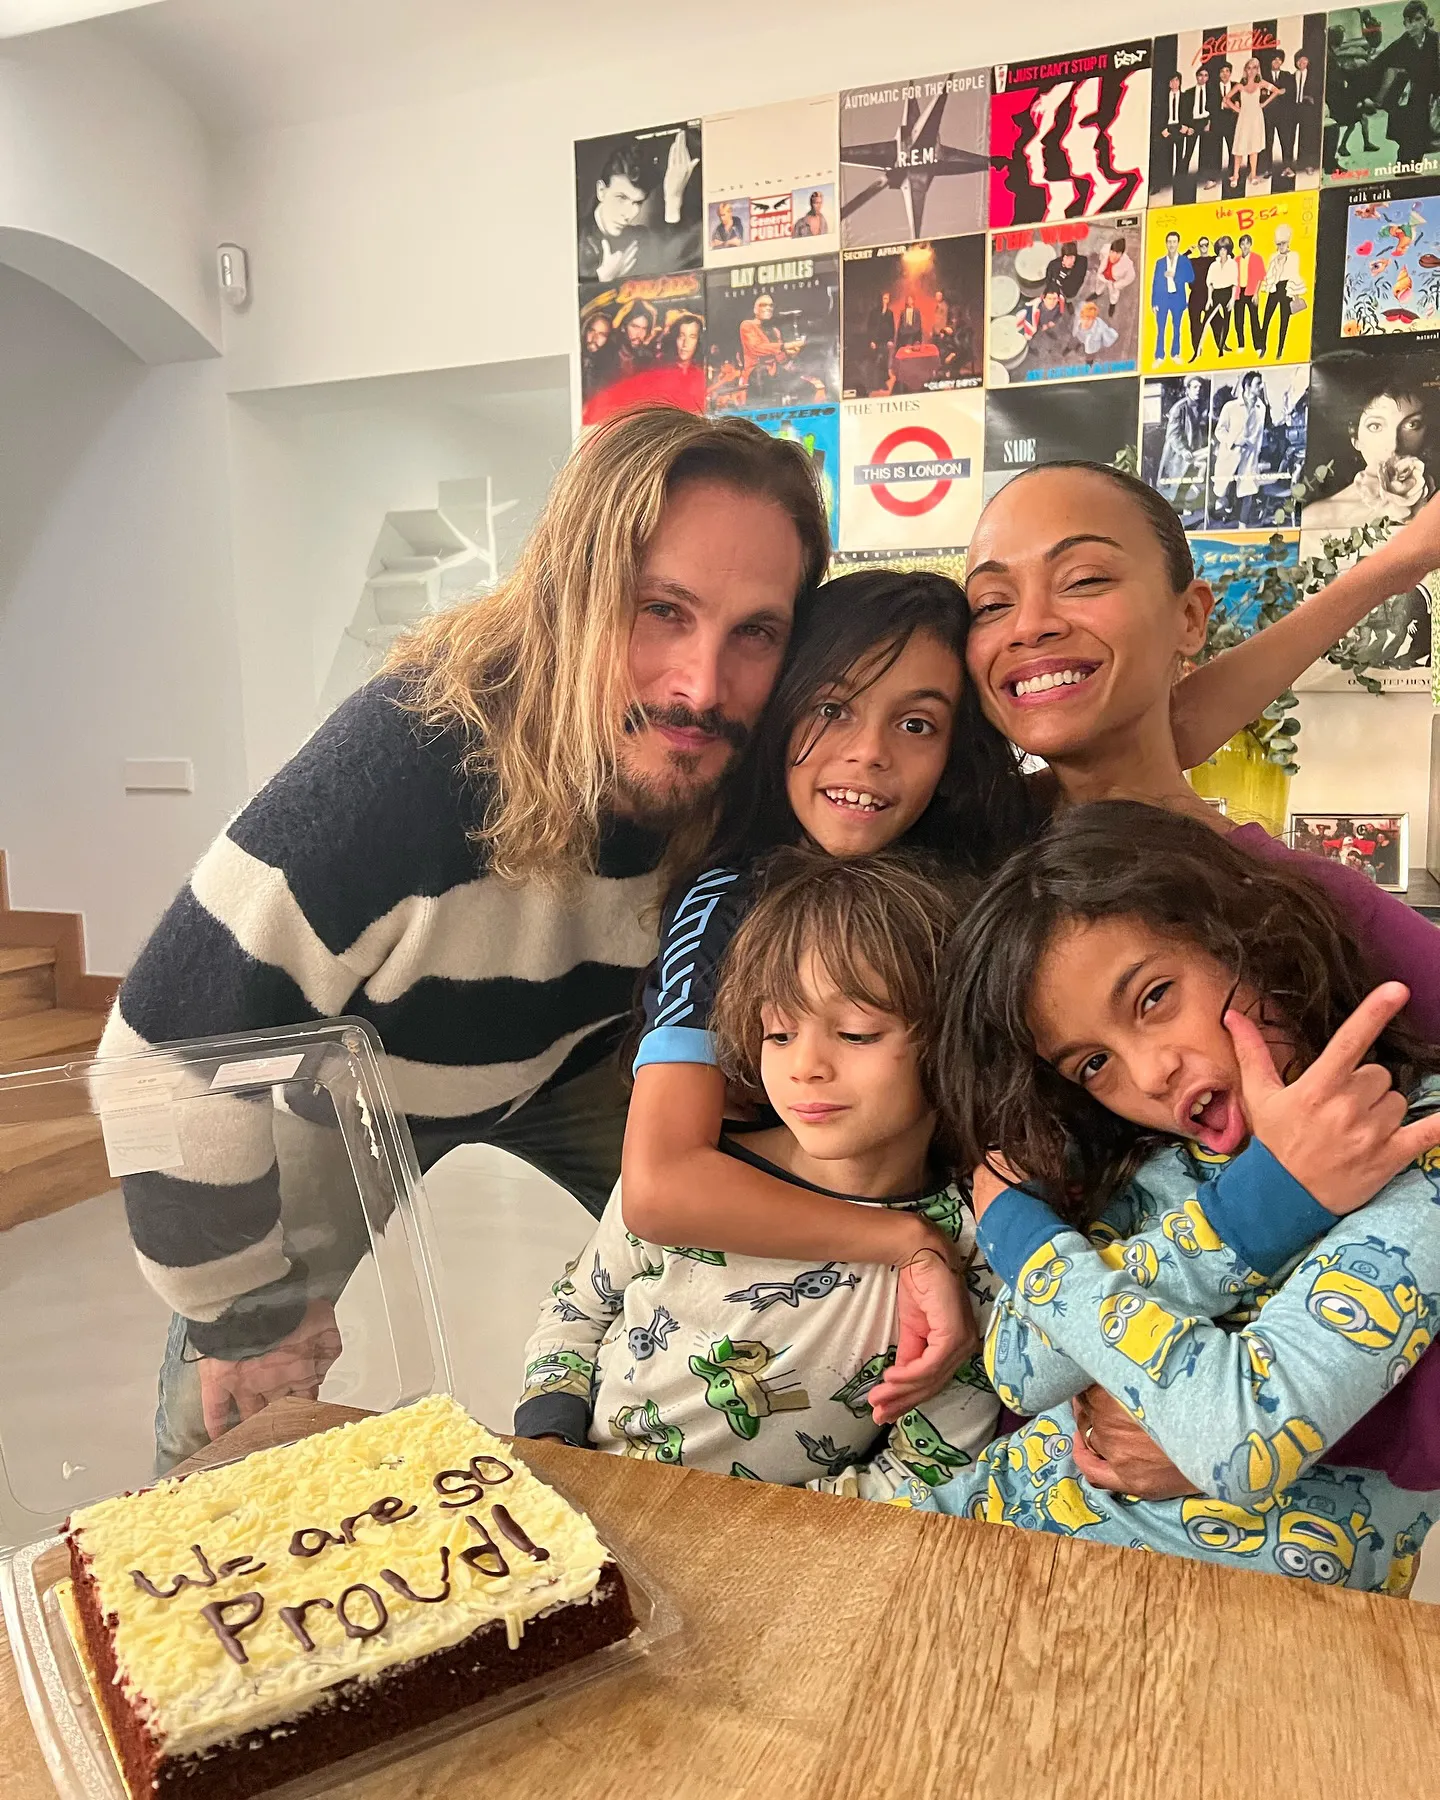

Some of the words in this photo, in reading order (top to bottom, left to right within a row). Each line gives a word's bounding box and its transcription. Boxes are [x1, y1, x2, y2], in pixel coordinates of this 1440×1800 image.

[1191, 27, 1280, 66] Blondie
[1008, 70, 1013, 84] I
[1013, 67, 1039, 83] JUST
[1040, 61, 1070, 79] CAN'T
[1071, 56, 1097, 73] STOP
[1098, 54, 1108, 68] IT
[844, 90, 899, 109] AUTOMATIC
[902, 86, 921, 100] FOR
[925, 82, 944, 97] THE
[946, 75, 985, 93] PEOPLE
[898, 147, 938, 168] R.E.M.
[1374, 158, 1438, 176] midnight
[1349, 191, 1367, 203] talk
[1372, 189, 1391, 201] talk
[1215, 206, 1232, 220] the
[751, 223, 791, 241] PUBLIC
[843, 250, 873, 261] SECRET
[758, 259, 814, 284] CHARLES
[844, 404, 873, 416] THE
[876, 400, 921, 414] TIMES
[1003, 438, 1036, 463] SADE
[862, 467, 891, 480] THIS
[893, 466, 906, 479] IS
[909, 463, 962, 478] LONDON
[128, 1543, 267, 1598] We
[288, 1496, 418, 1558] are
[433, 1455, 514, 1508] so
